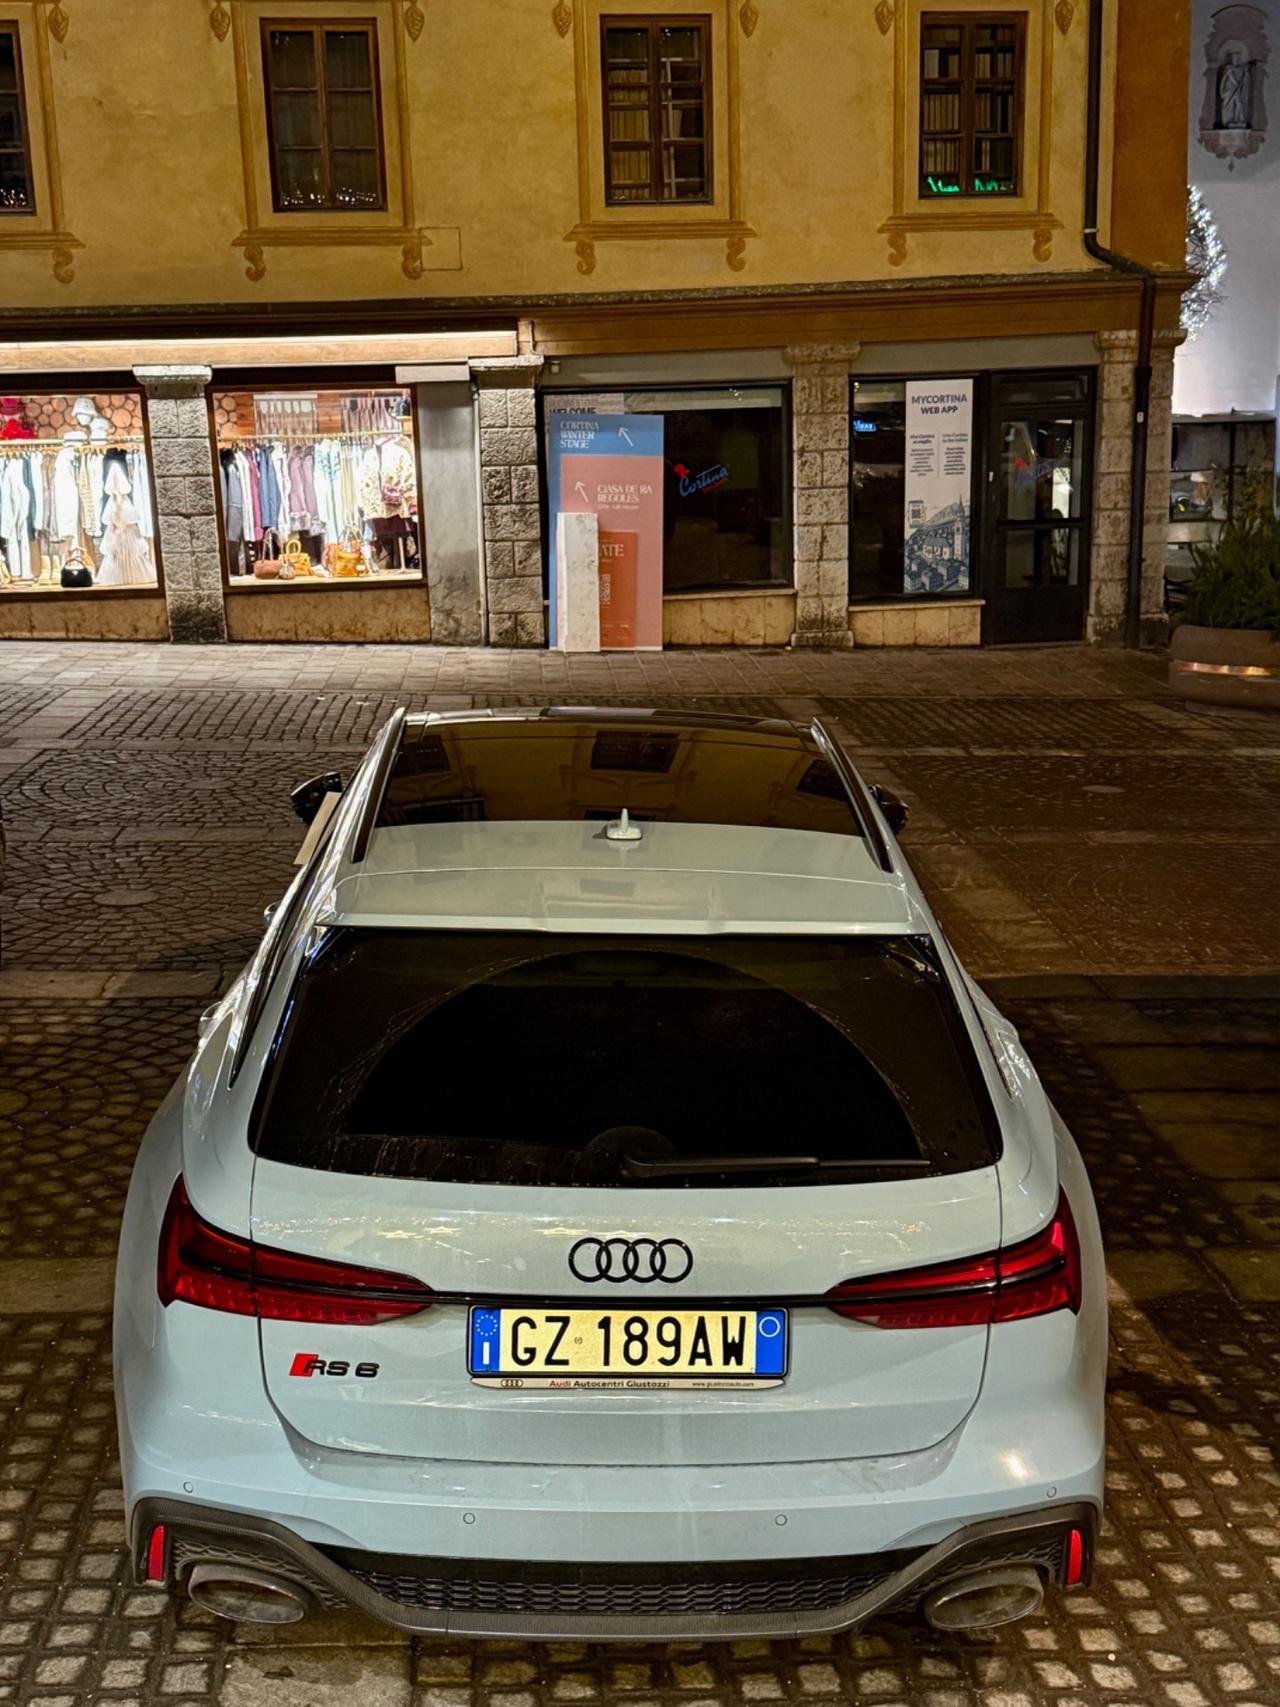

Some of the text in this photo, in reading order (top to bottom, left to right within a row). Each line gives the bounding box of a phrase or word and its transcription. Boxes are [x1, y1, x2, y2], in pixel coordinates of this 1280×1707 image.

[911, 394, 967, 404] MYCORTINA
[921, 405, 959, 415] WEB APP
[560, 421, 600, 431] CORTINA
[560, 431, 596, 440] WINTER
[560, 440, 590, 449] STAGE
[680, 464, 729, 497] Cortina
[625, 484, 639, 494] DE
[640, 484, 653, 494] RA
[511, 1316, 570, 1366] GZ
[597, 1316, 746, 1366] 189AW
[302, 1359, 380, 1378] RS 6
[549, 1380, 572, 1388] Audi
[573, 1380, 624, 1388] Autocentri
[626, 1380, 670, 1388] Giustozzi
